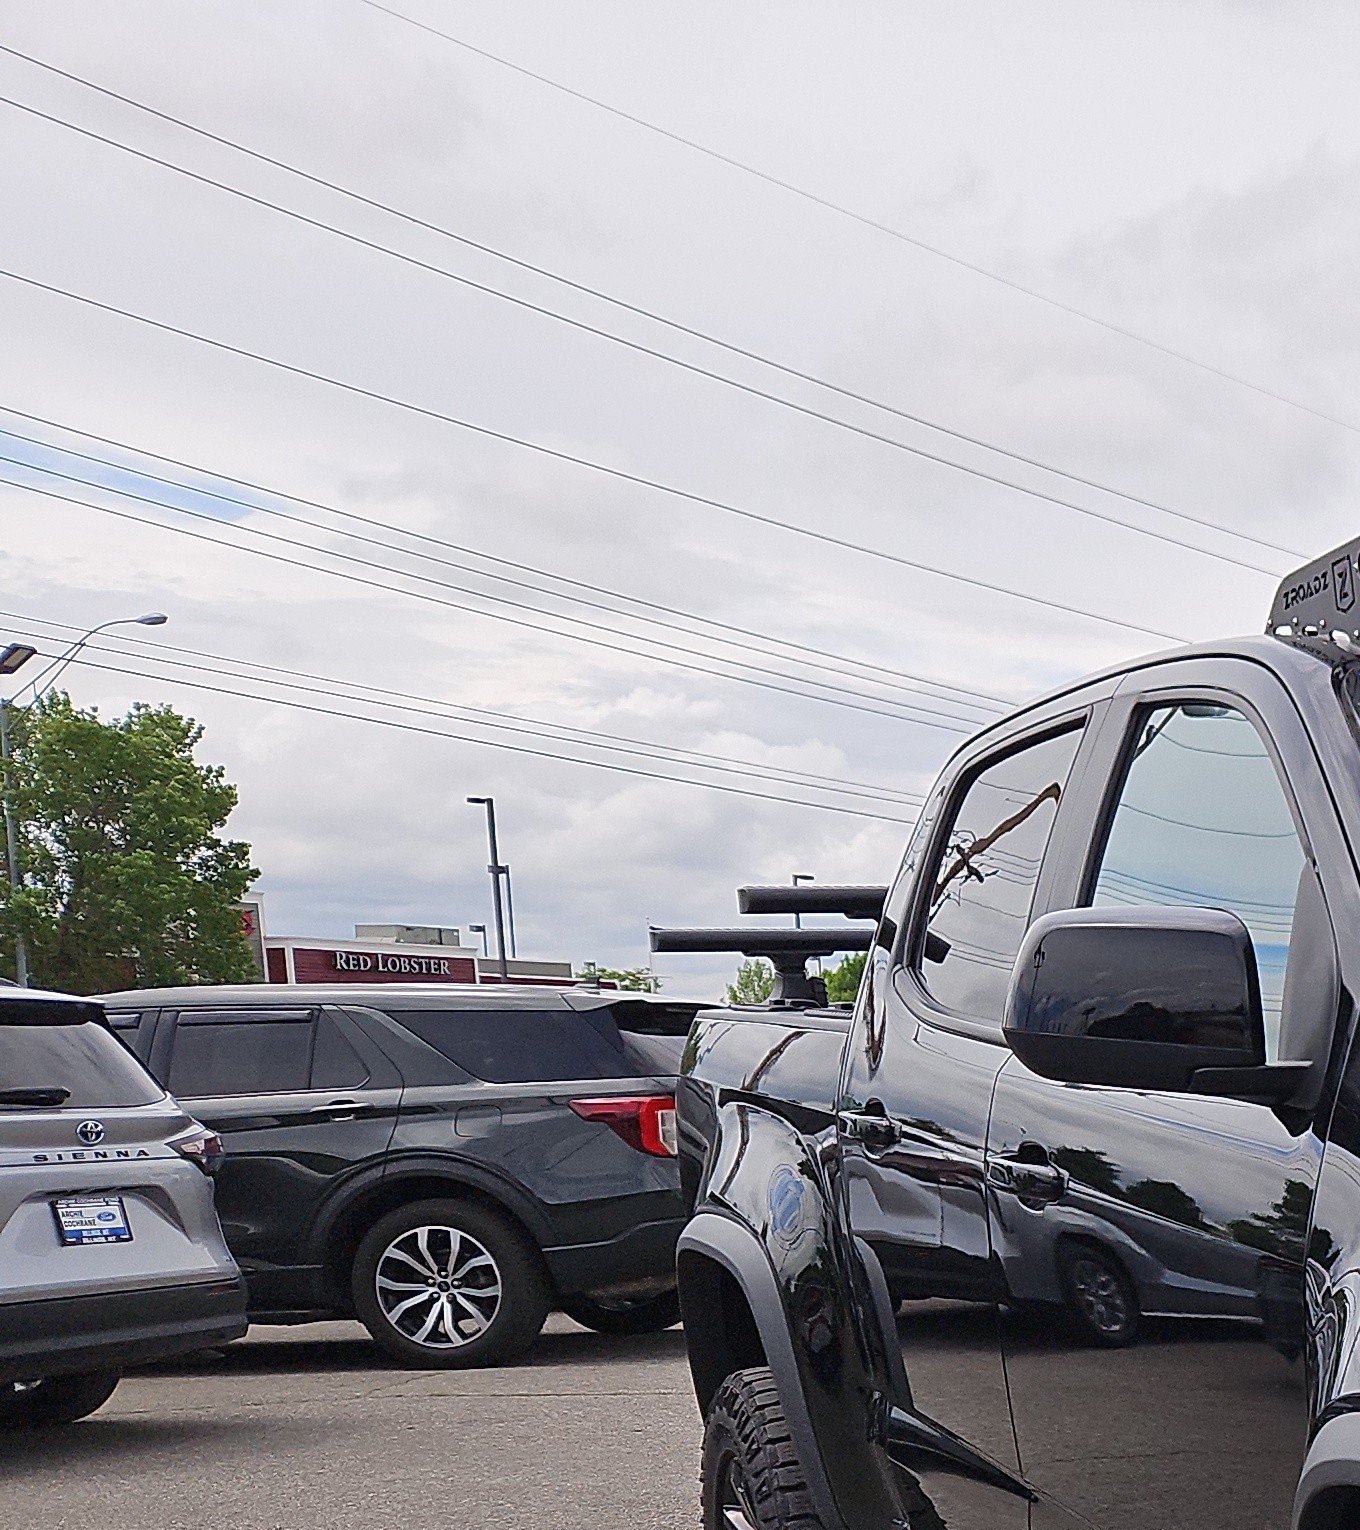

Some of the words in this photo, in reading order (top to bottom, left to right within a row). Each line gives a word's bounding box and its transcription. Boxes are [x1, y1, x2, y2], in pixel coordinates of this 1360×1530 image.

[1282, 571, 1330, 611] ZROADZ
[334, 951, 372, 971] RED
[377, 953, 451, 975] LOBSTER
[32, 1149, 150, 1162] SIENNA
